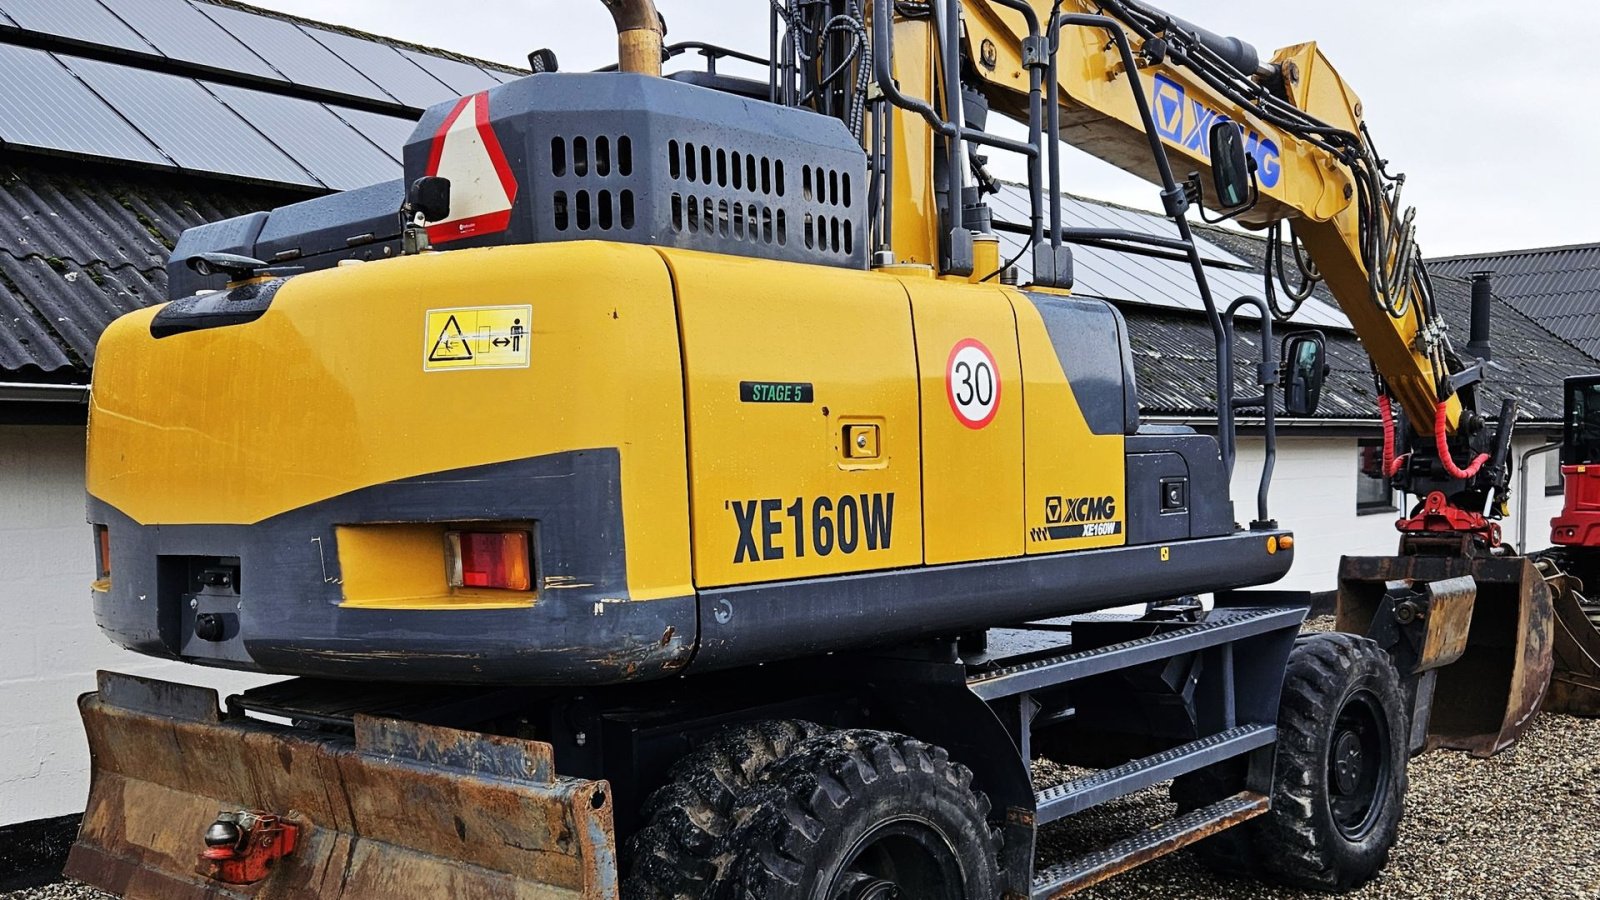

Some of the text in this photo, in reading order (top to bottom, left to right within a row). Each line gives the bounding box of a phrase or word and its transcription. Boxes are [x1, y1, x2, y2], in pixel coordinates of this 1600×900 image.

[752, 384, 802, 402] STAGE 5
[955, 361, 993, 406] 30
[1062, 495, 1116, 523] XCMG
[731, 492, 895, 564] XE160W
[1081, 522, 1116, 537] XE160W
